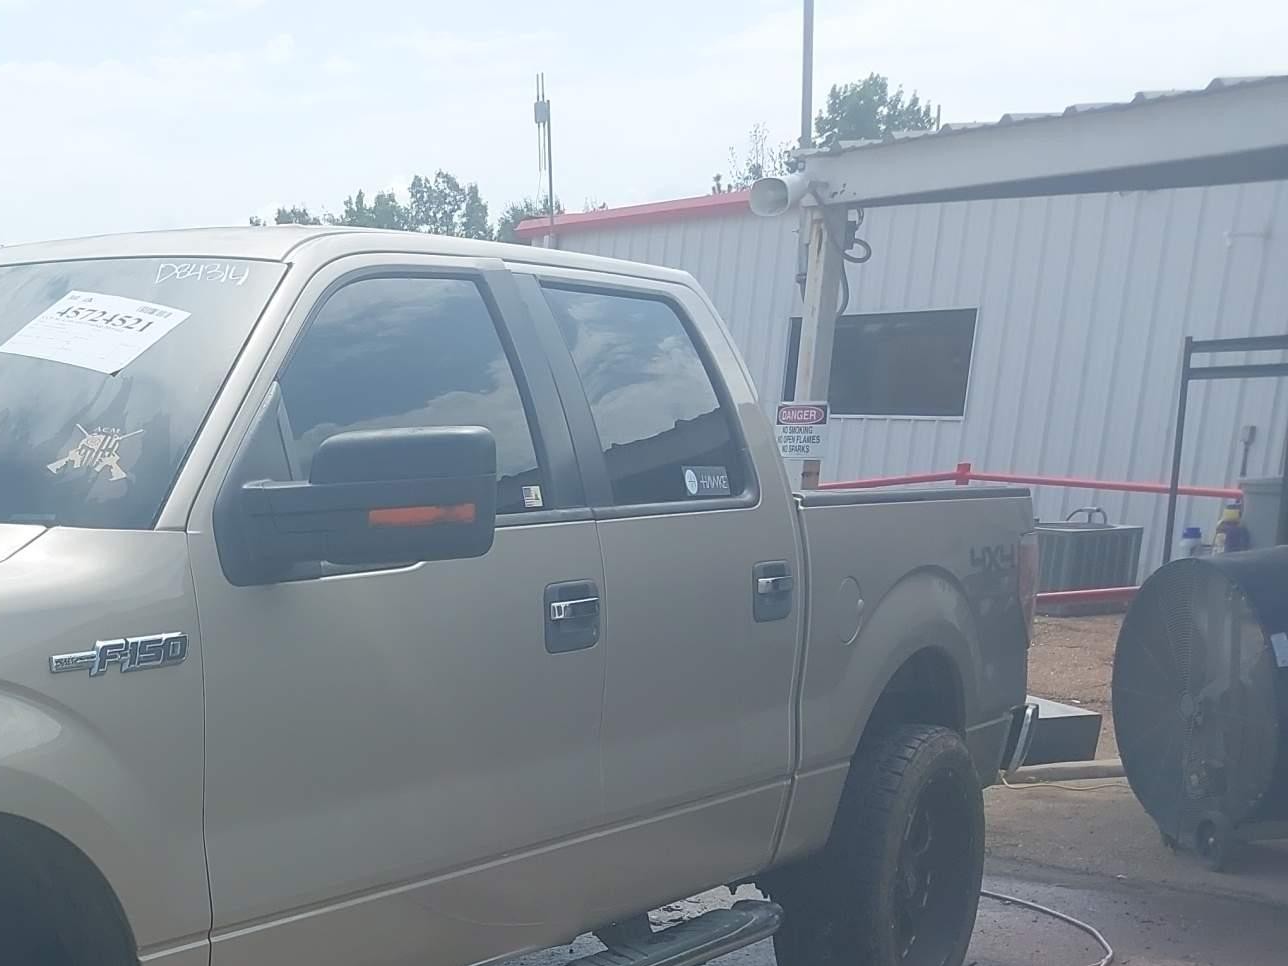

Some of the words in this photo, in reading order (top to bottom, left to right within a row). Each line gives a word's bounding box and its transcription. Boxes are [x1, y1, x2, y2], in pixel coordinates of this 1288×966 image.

[57, 305, 154, 332] 45724521
[782, 409, 817, 421] DANGER
[789, 426, 813, 434] SMOKING
[796, 435, 821, 443] FLAMES
[788, 445, 810, 453] SPARKS
